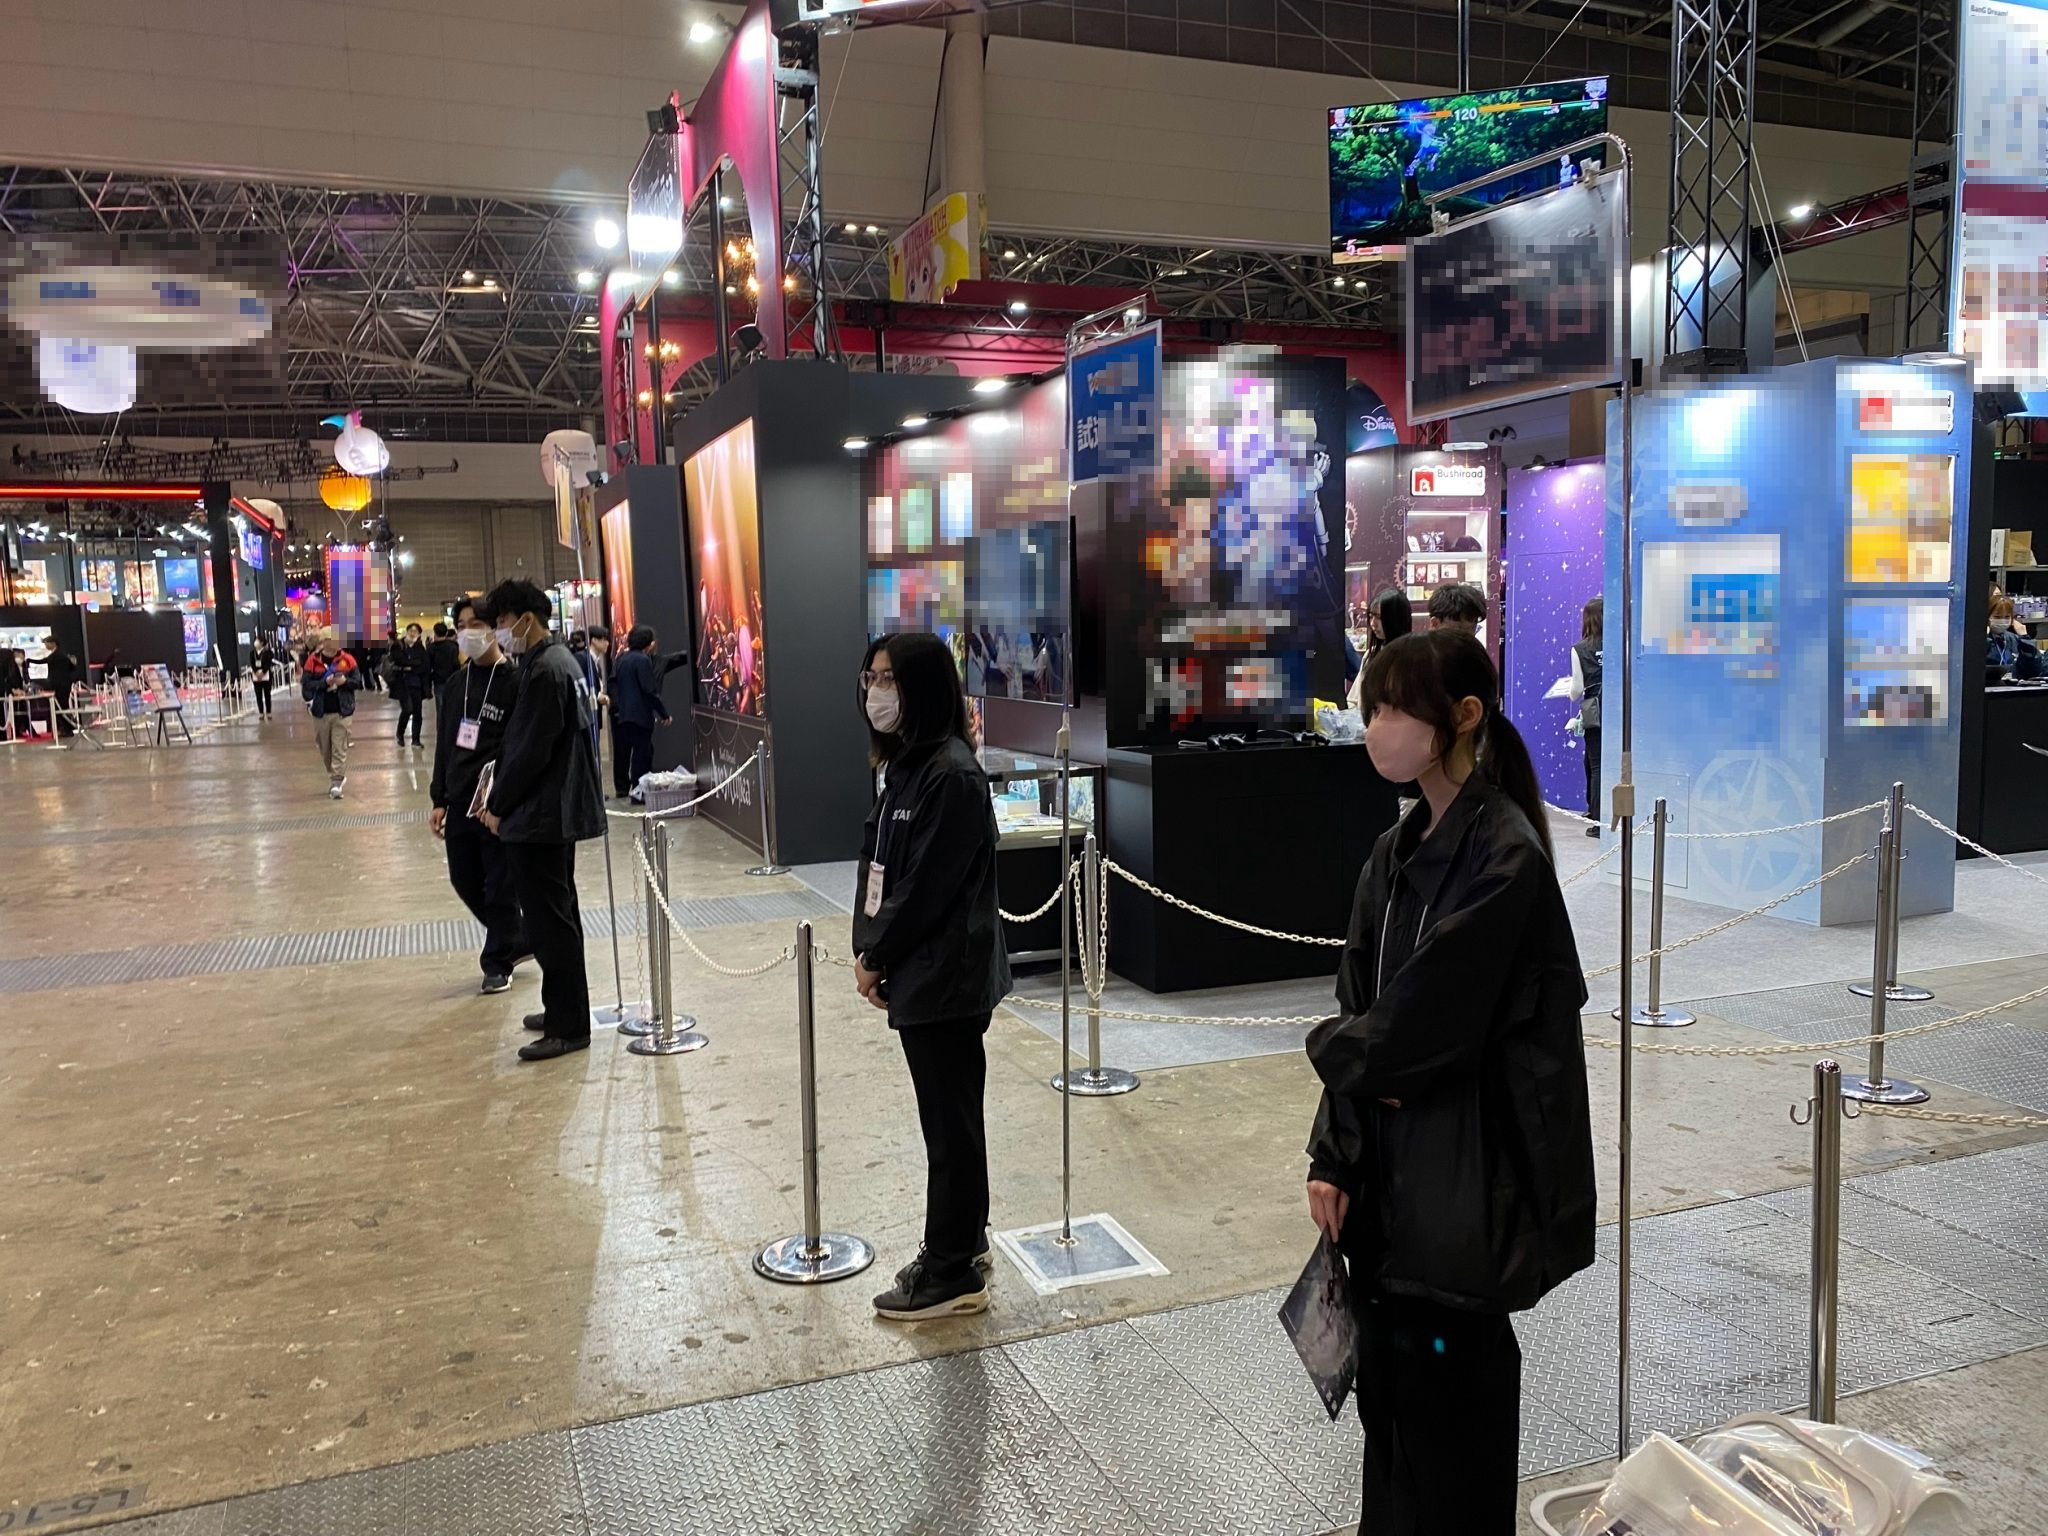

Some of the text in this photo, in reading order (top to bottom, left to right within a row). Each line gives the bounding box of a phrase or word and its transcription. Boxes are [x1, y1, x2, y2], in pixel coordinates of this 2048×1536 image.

[1970, 4, 1986, 14] BanG
[1454, 108, 1477, 121] 120
[1437, 468, 1483, 478] Bushiroad
